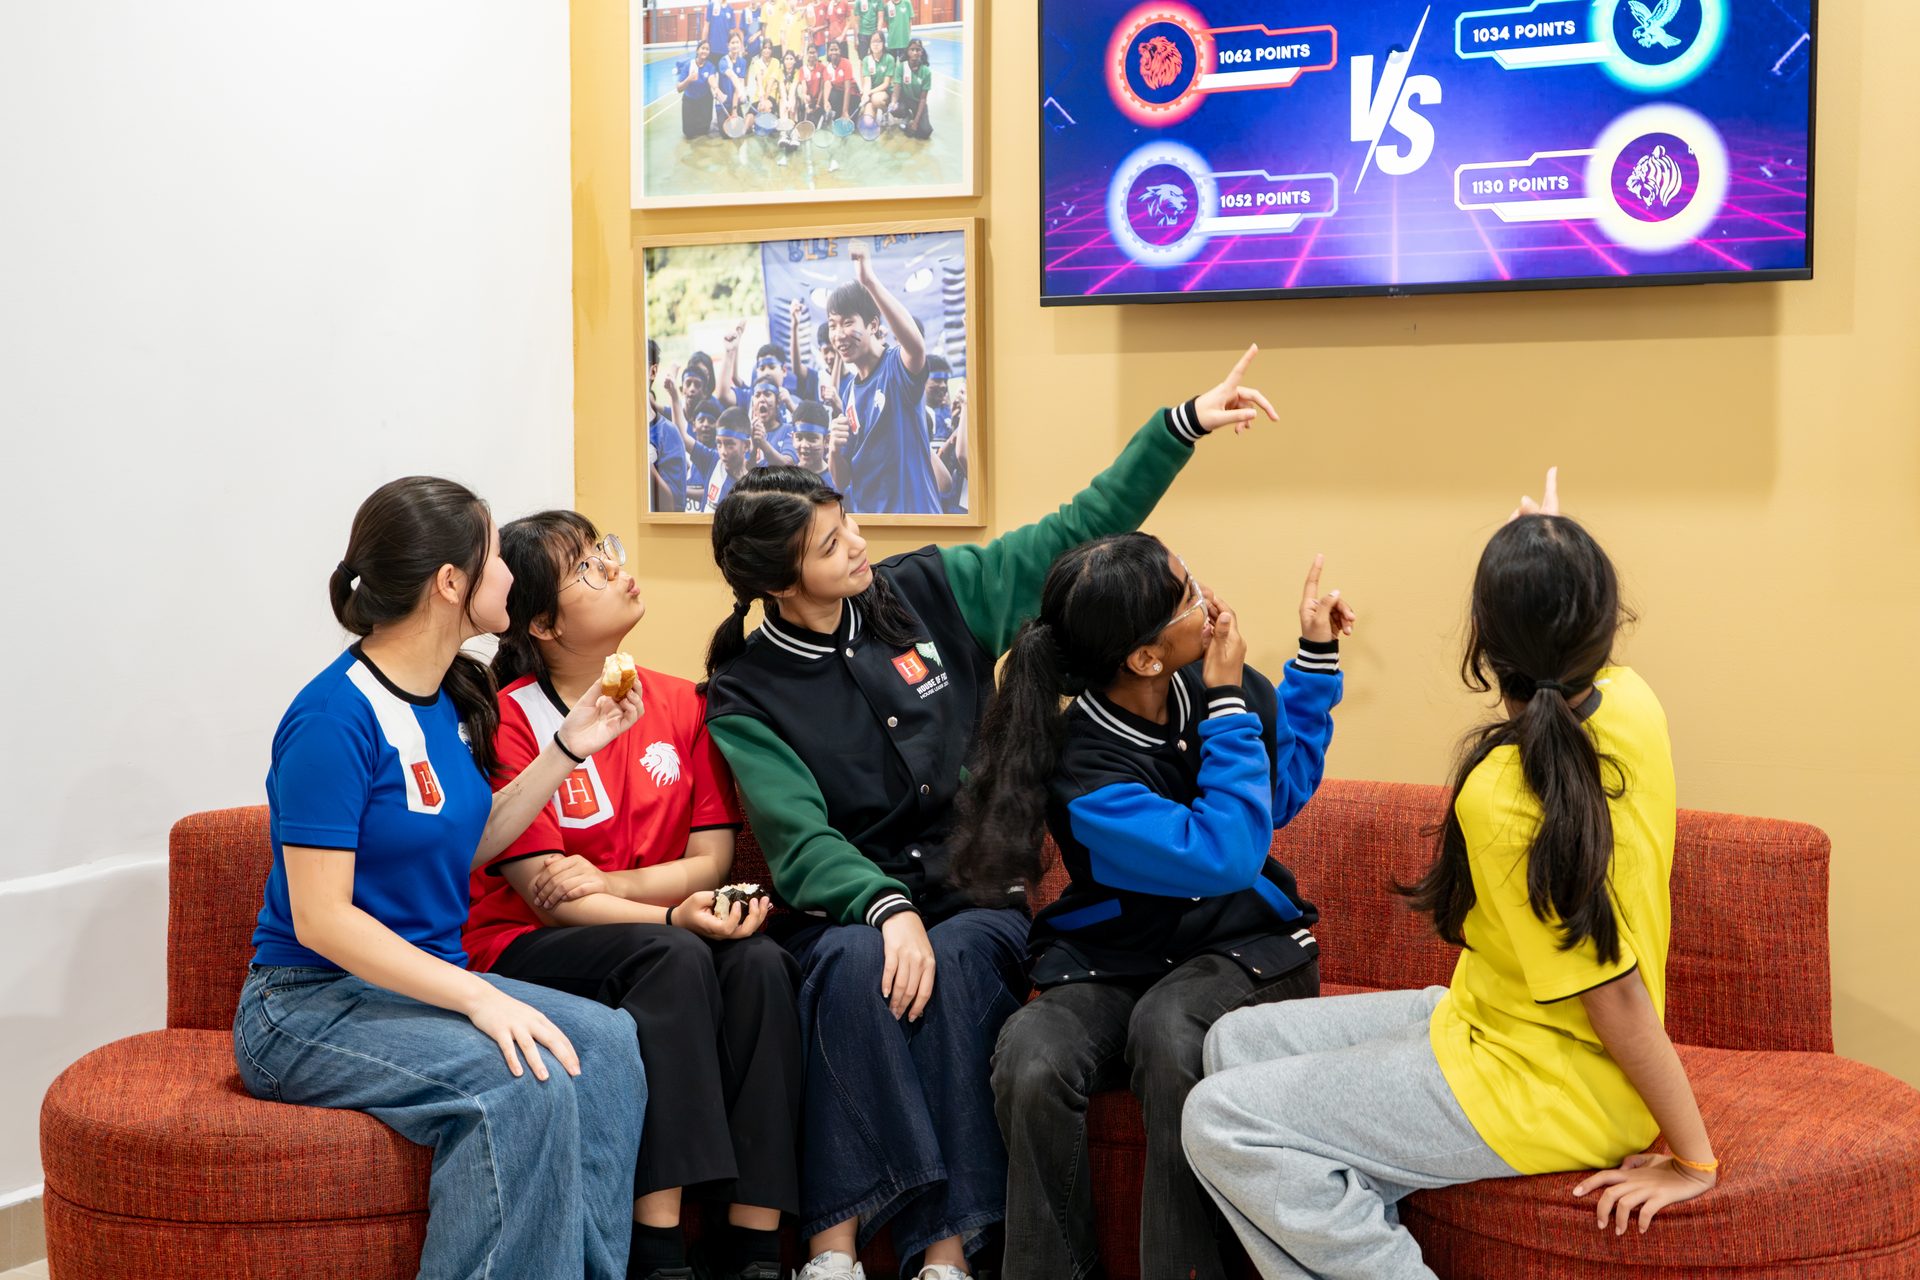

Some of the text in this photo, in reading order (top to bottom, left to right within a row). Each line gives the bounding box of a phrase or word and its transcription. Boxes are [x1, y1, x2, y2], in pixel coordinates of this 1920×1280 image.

[1472, 20, 1576, 43] 1034 POINTS
[1219, 43, 1311, 65] 1062 POINTS
[1350, 50, 1443, 176] VS
[1472, 175, 1569, 194] 1130 POINTS
[1220, 190, 1311, 208] 1052 POINTS
[787, 236, 838, 262] BLUE
[899, 658, 922, 678] H
[916, 678, 936, 694] HOUSE
[419, 771, 436, 794] H
[564, 777, 592, 805] H
